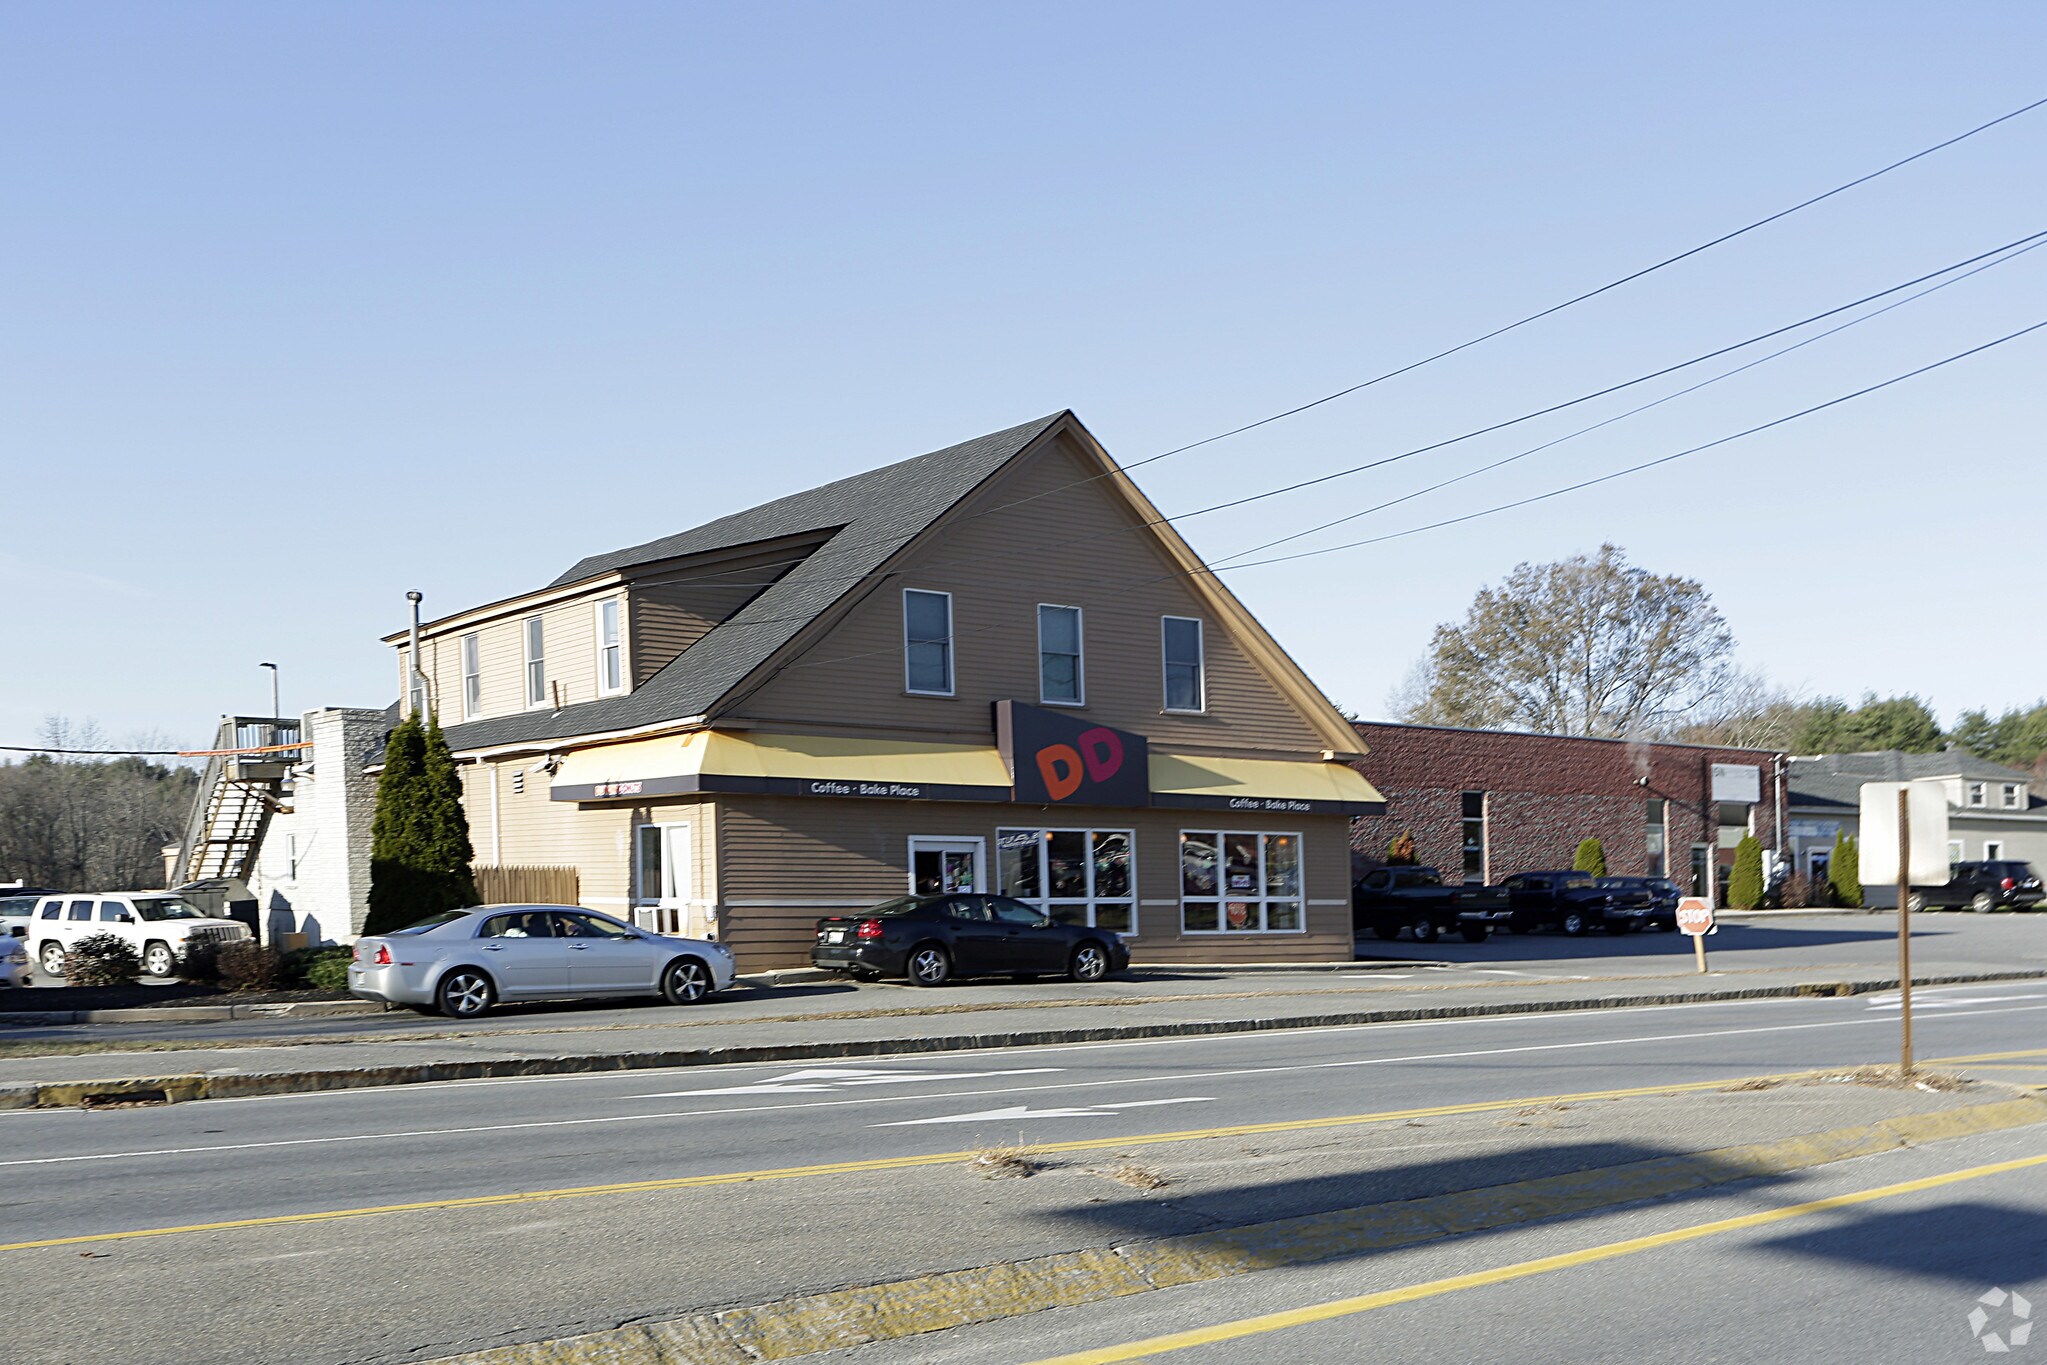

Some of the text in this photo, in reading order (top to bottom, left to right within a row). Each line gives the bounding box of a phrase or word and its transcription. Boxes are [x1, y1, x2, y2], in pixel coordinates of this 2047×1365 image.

[1035, 727, 1124, 801] DD
[811, 782, 920, 797] Coffee Bake Place
[1229, 798, 1311, 812] Coffee Bake Place
[1679, 909, 1710, 923] STOP
